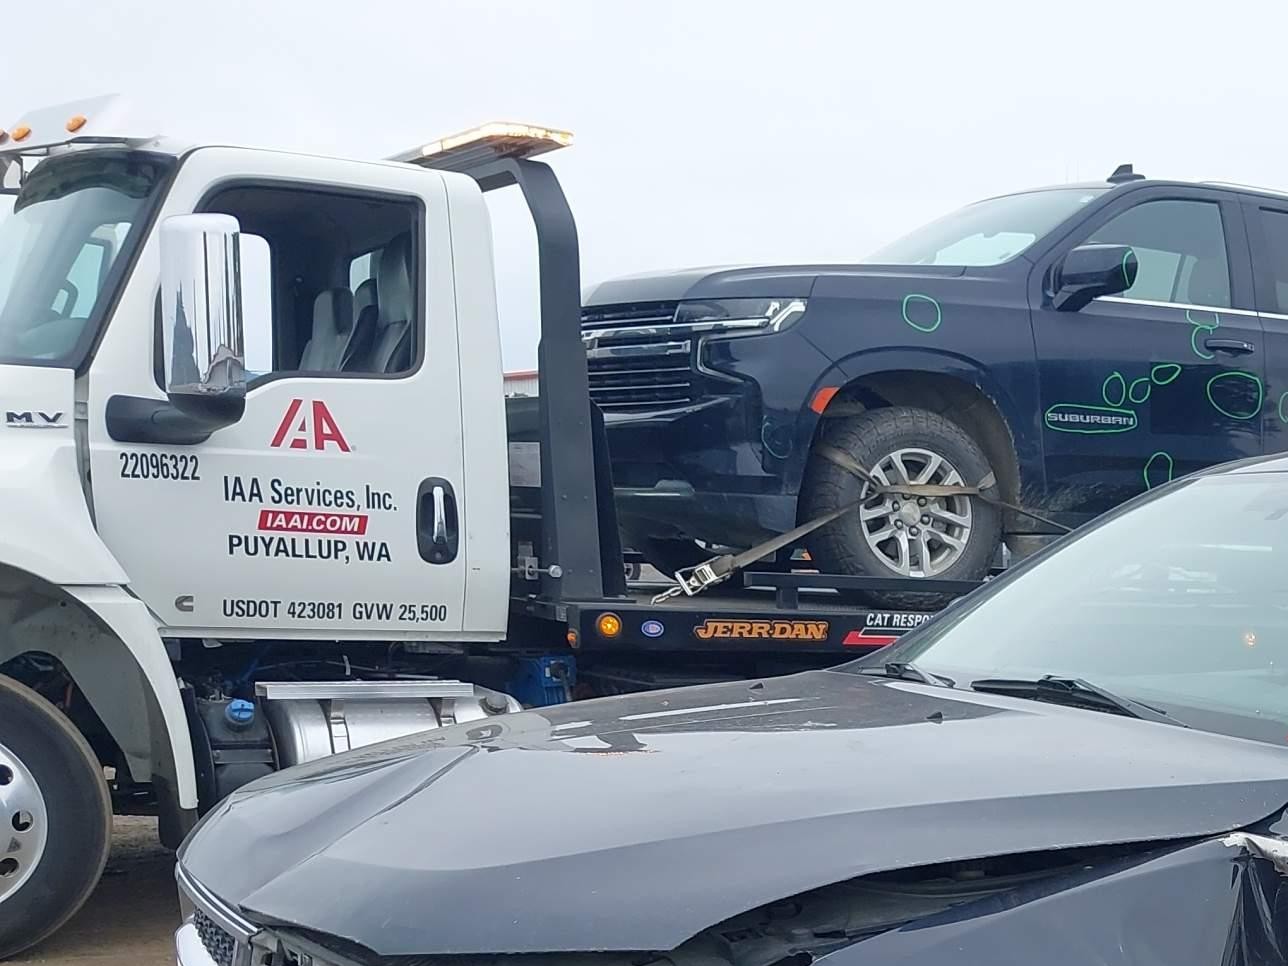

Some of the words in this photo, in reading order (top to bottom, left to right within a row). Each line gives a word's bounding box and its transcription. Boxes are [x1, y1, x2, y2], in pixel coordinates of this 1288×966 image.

[6, 411, 63, 423] MV
[1047, 412, 1134, 426] SUBURBAN
[119, 452, 200, 481] 22096322
[223, 475, 263, 503] IAA
[270, 480, 361, 512] Services,
[365, 484, 397, 511] Inc.
[265, 512, 359, 532] IAAI.COM
[227, 534, 350, 564] PUYALLUP,
[354, 541, 391, 562] WA
[222, 599, 281, 619] USDOT
[287, 601, 343, 620] 423081
[352, 602, 393, 620] GVW
[398, 603, 447, 622] 25,500
[866, 612, 890, 627] CAT
